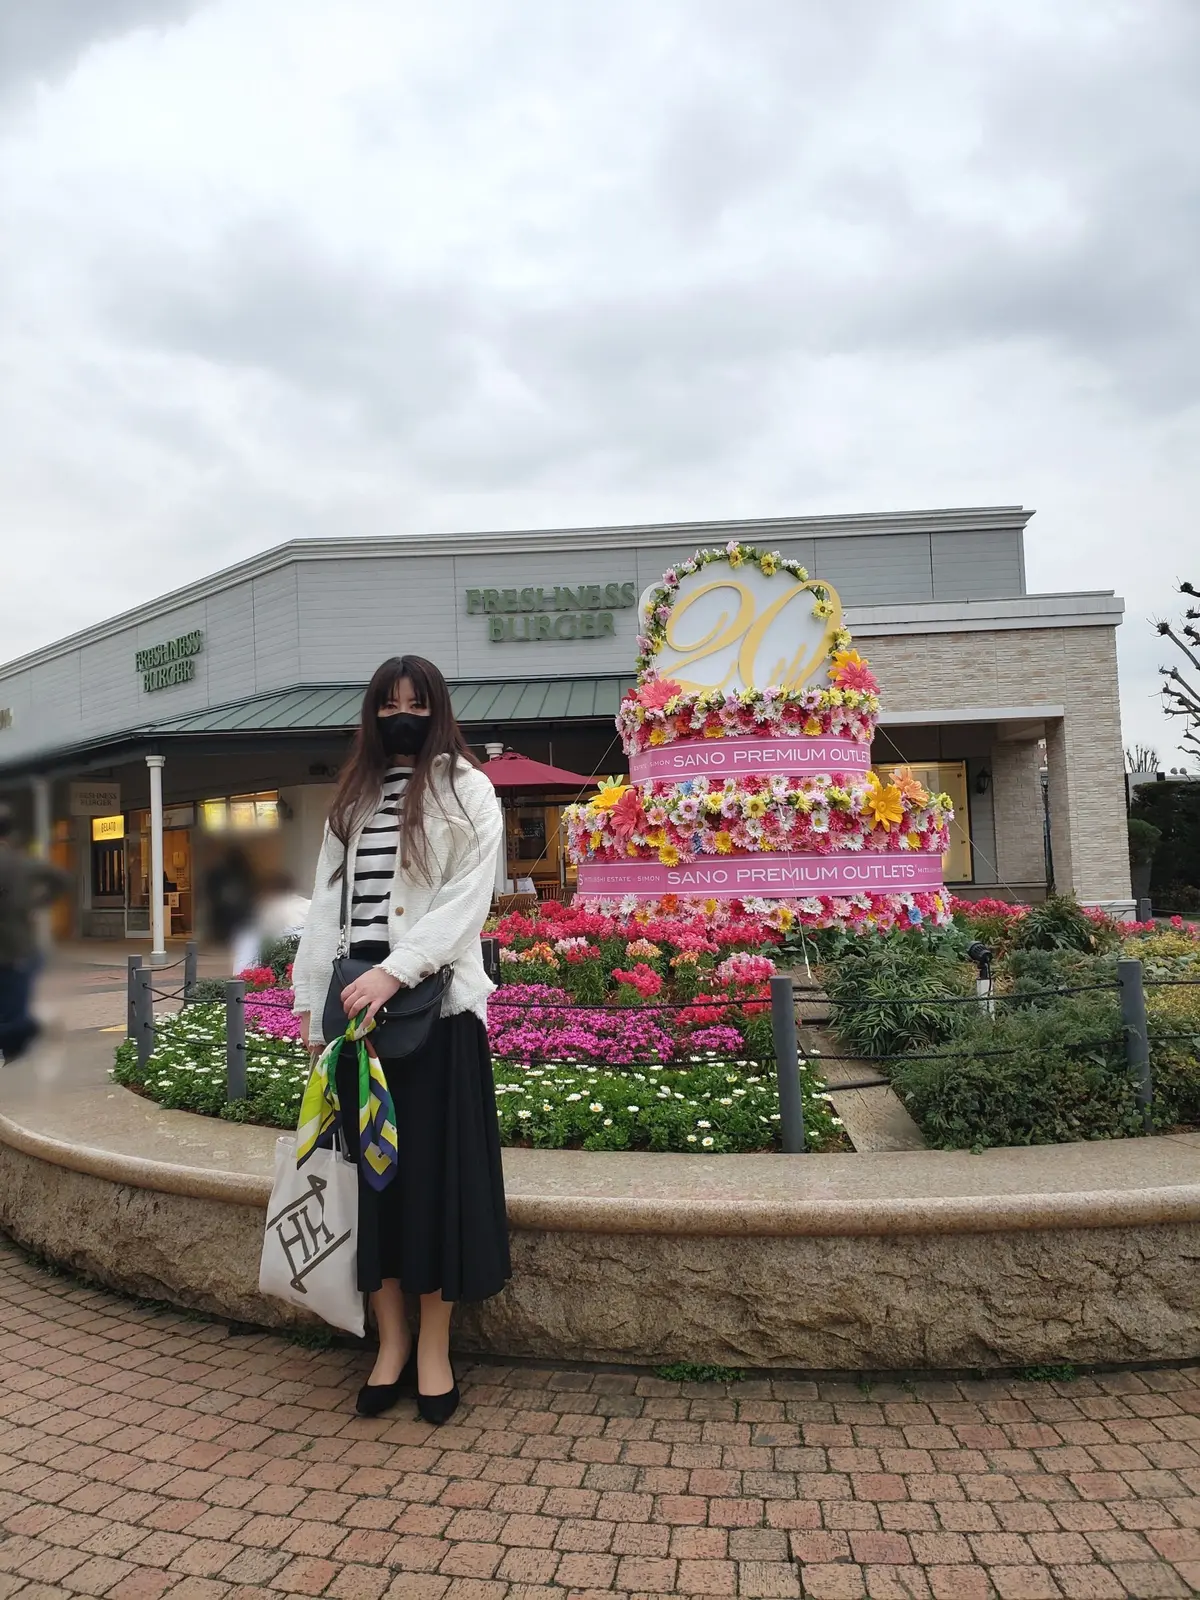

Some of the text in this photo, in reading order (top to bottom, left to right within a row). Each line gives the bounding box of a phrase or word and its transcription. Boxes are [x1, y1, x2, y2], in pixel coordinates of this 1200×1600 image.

[465, 582, 635, 614] FRESHNESS
[488, 612, 616, 642] BURGER
[135, 629, 203, 672] FRESHNESS
[143, 659, 195, 693] BURGER
[673, 751, 725, 768] SANO
[733, 748, 826, 764] PREMIUM
[667, 870, 728, 885] SANO
[736, 867, 838, 883] PREMIUM
[842, 864, 916, 880] OUTLETS
